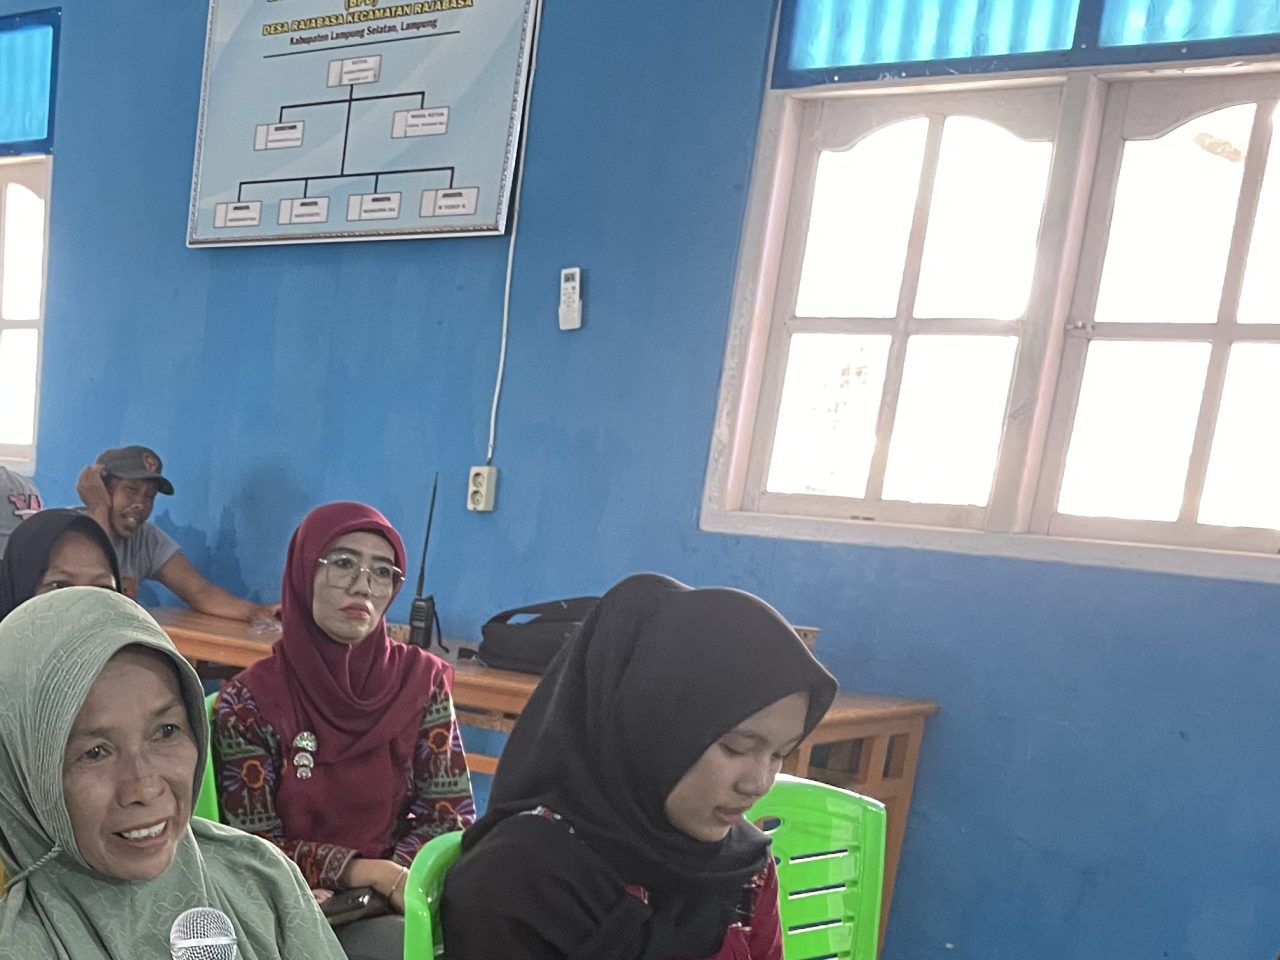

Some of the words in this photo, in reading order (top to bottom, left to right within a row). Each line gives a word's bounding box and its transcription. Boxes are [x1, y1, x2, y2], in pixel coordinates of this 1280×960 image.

[262, 22, 289, 36] DESA
[291, 13, 344, 32] RAJABASA
[345, 3, 413, 24] KECAMATAN
[290, 34, 329, 45] Kabupaten
[331, 29, 365, 39] Lampung
[401, 18, 438, 31] Lampung
